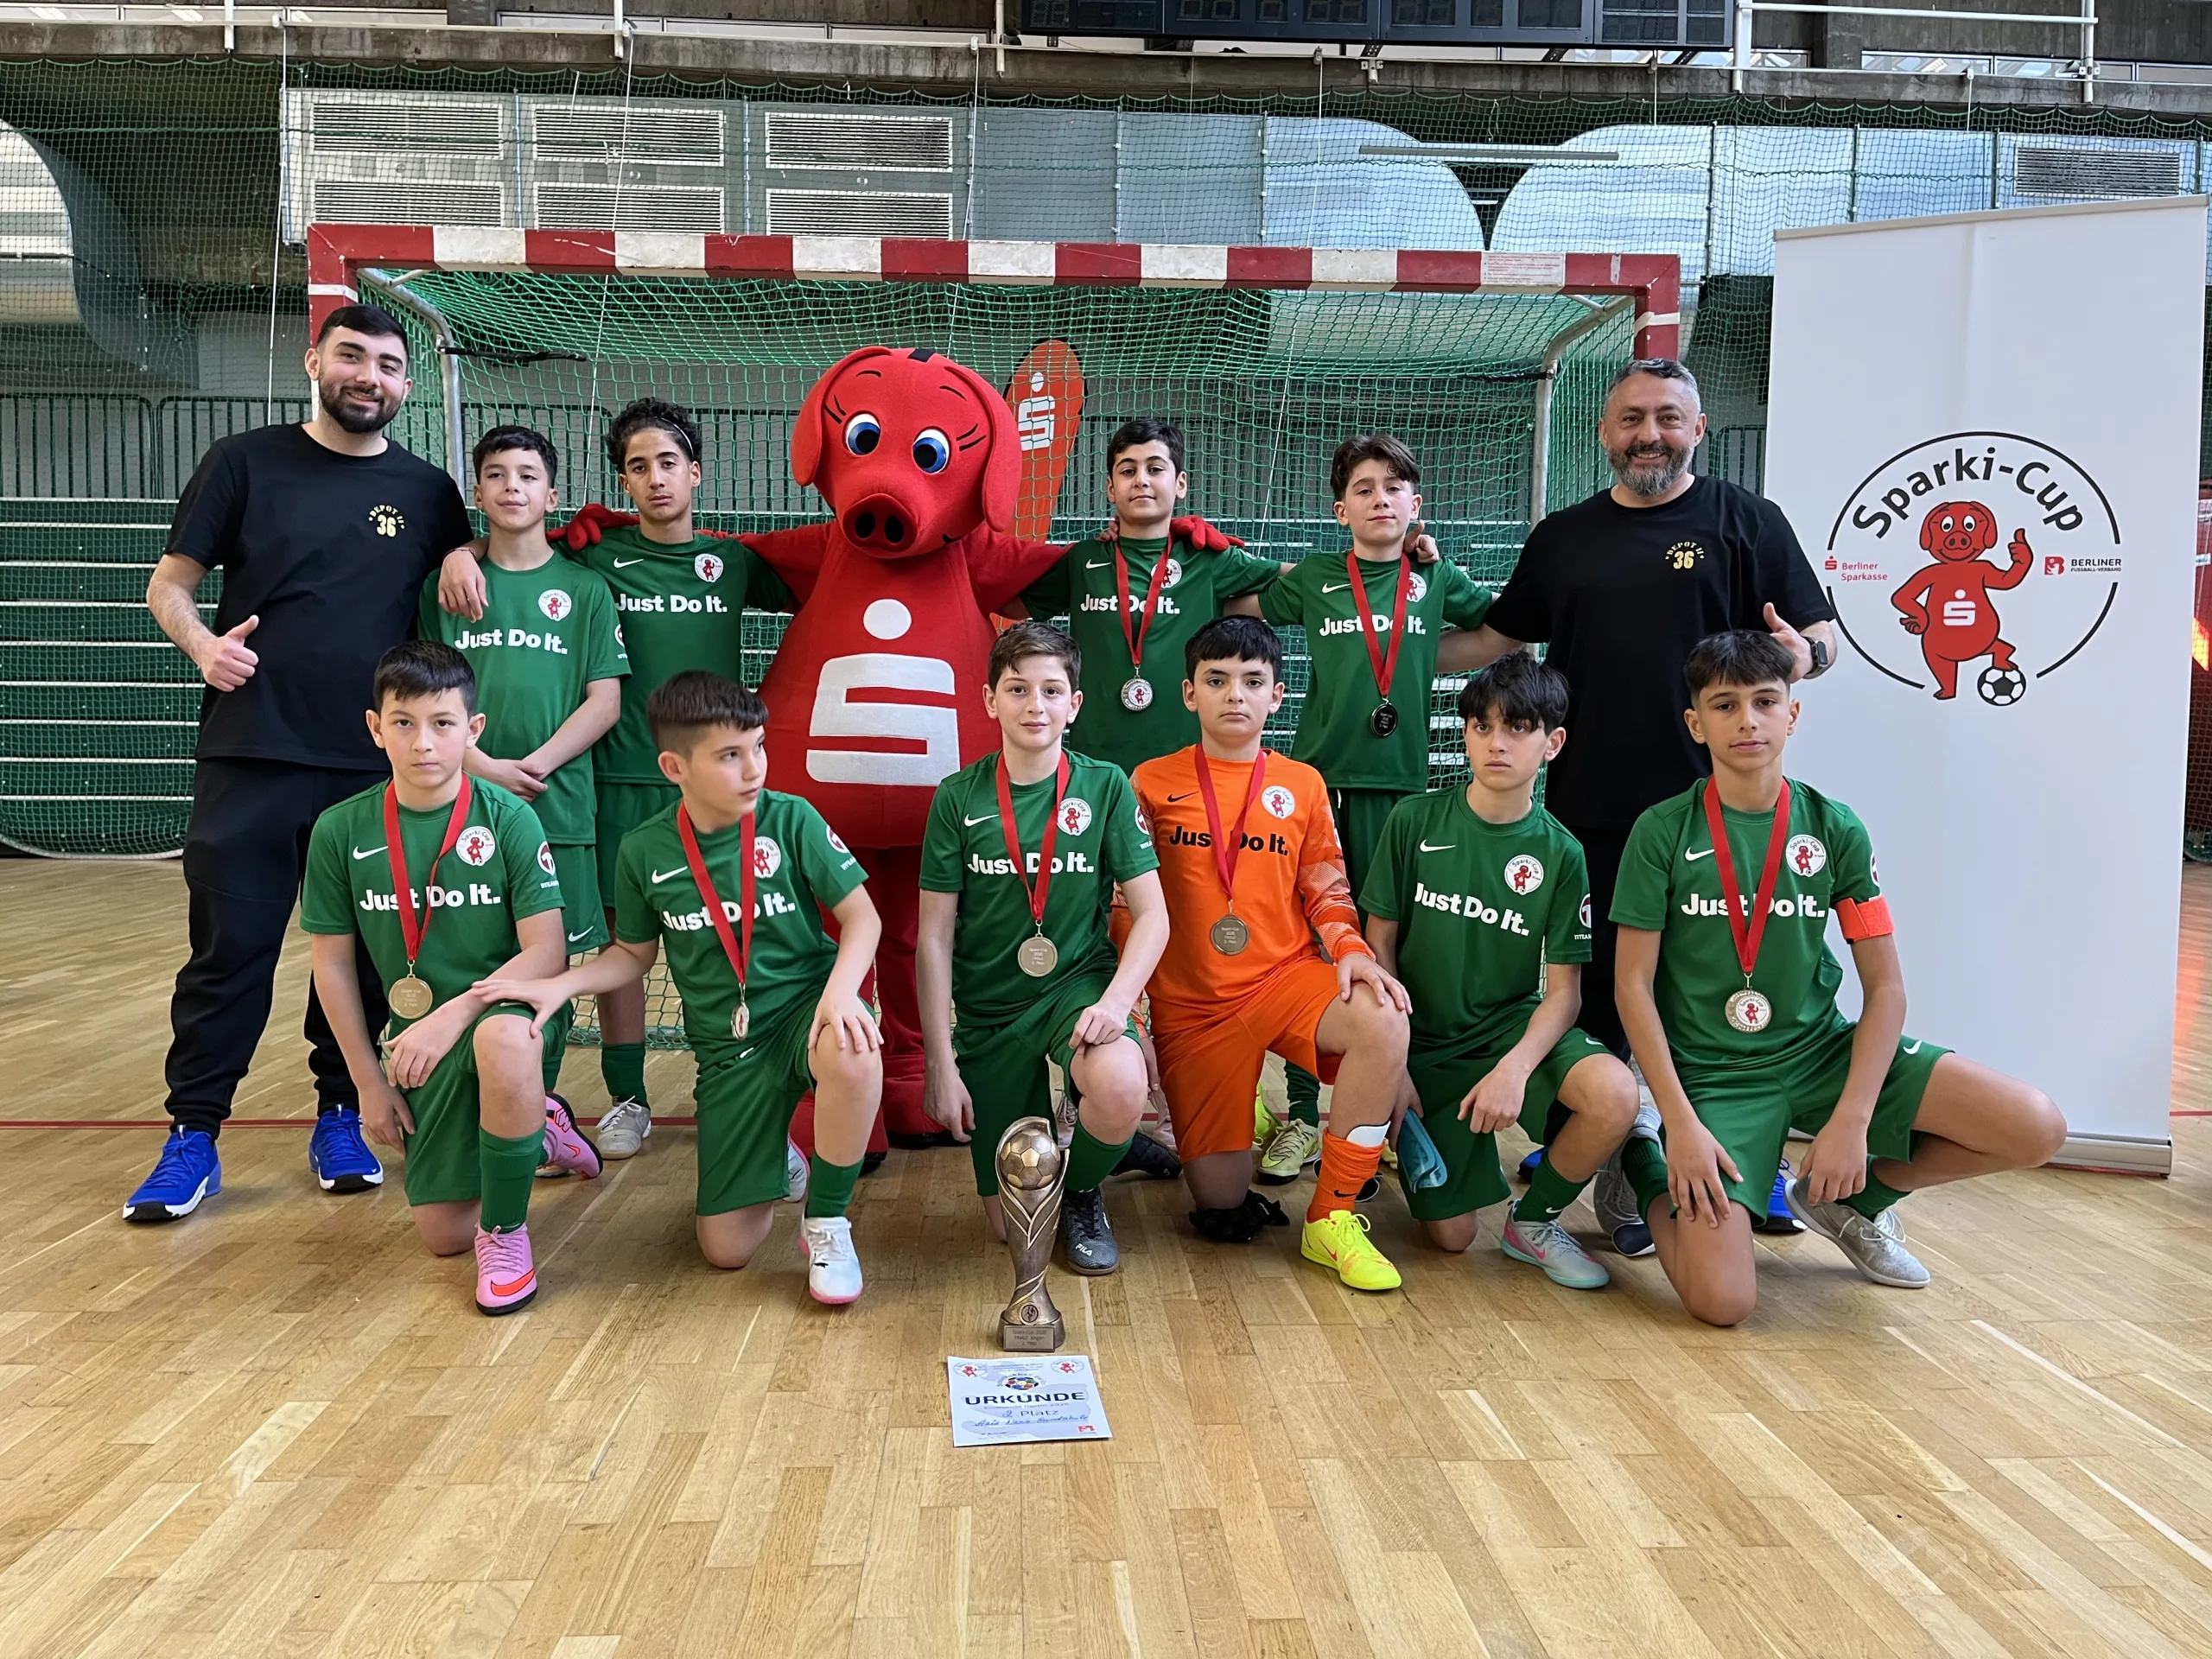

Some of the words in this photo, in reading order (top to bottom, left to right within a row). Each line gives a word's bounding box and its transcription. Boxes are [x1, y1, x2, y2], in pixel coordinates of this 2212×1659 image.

[1853, 447, 2083, 539] Sparki-Cup
[369, 505, 398, 517] DEPOT
[377, 514, 397, 537] 36
[1667, 541, 1697, 555] DEPOT
[1673, 550, 1694, 569] 36
[1841, 562, 1878, 570] Berliner
[2070, 558, 2122, 567] BERLINER
[1841, 573, 1888, 583] Sparkasse
[615, 594, 664, 612] Just
[670, 594, 702, 613] Do
[706, 595, 728, 613] It.
[1080, 594, 1119, 612] Just
[1157, 596, 1180, 614] It.
[1319, 615, 1364, 636] Just
[1408, 615, 1427, 635] It.
[454, 628, 503, 650] Just
[507, 628, 541, 649] Do
[543, 632, 569, 655] It.
[1169, 825, 1212, 848] Jus
[1268, 833, 1288, 856] It.
[1789, 838, 1820, 852] Sparki-Cup
[1066, 851, 1094, 873] It.
[1511, 858, 1539, 874] Sparki-Cup
[426, 886, 464, 907] Do
[469, 883, 501, 906] It.
[663, 906, 715, 931] Just
[763, 892, 796, 917] It.
[1414, 882, 1462, 915] Just
[1463, 895, 1498, 925] Do
[1500, 908, 1529, 937] It.
[1797, 893, 1826, 918] It.
[1075, 1243, 1093, 1256] FILA
[965, 1391, 1086, 1405] URKUNDE
